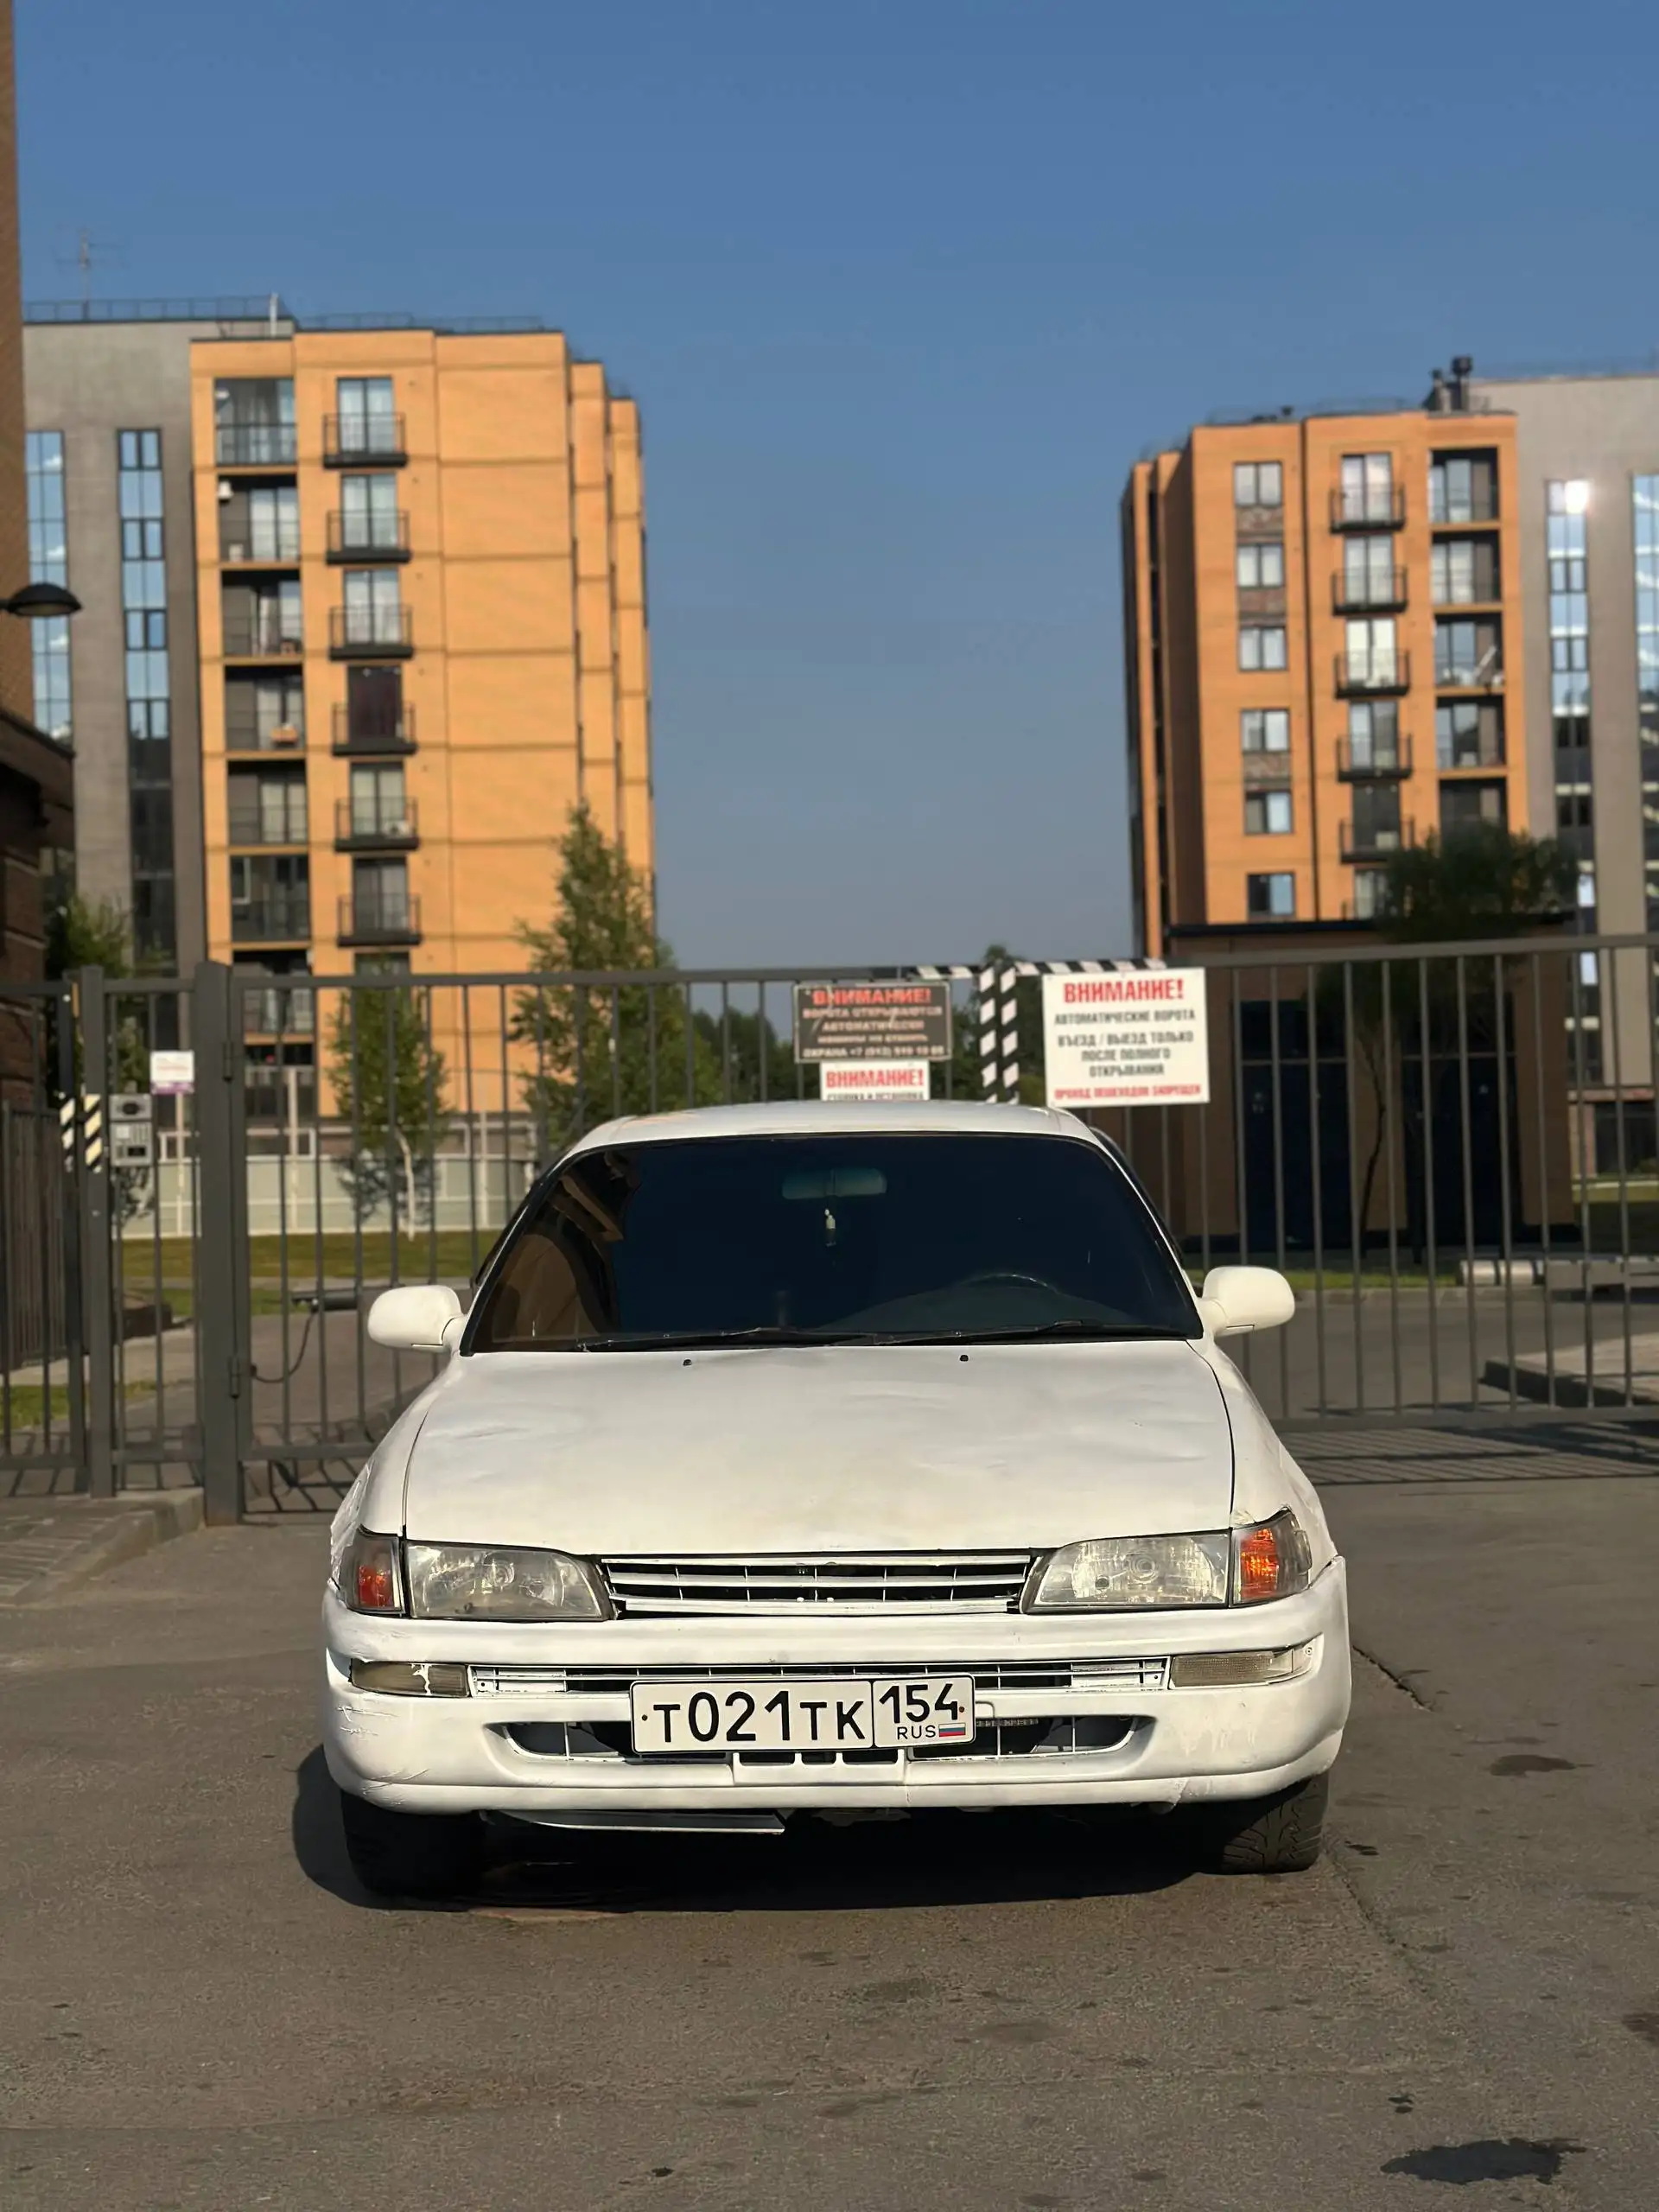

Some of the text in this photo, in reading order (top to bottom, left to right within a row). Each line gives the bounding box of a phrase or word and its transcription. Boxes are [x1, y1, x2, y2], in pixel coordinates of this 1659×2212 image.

[812, 988, 931, 1005] ВНИМАНИЕ!
[1064, 978, 1184, 1003] ВНИМАНИЕ!
[1054, 1008, 1195, 1025] АВТОМАТИЧЕСКИЕ ВОРОТА
[1058, 1035, 1096, 1047] ВЪЕЗД
[1107, 1033, 1147, 1046] ВЫЕЗД
[1151, 1031, 1193, 1043] ТОЛЬКО
[1082, 1048, 1171, 1061] ПОСЛЕ ПОЛНОГО
[826, 1070, 924, 1088] ВНИМАНИЕ!
[880, 1683, 959, 1724] 154
[653, 1690, 865, 1742] Т021ТК
[897, 1725, 936, 1740] RUS
